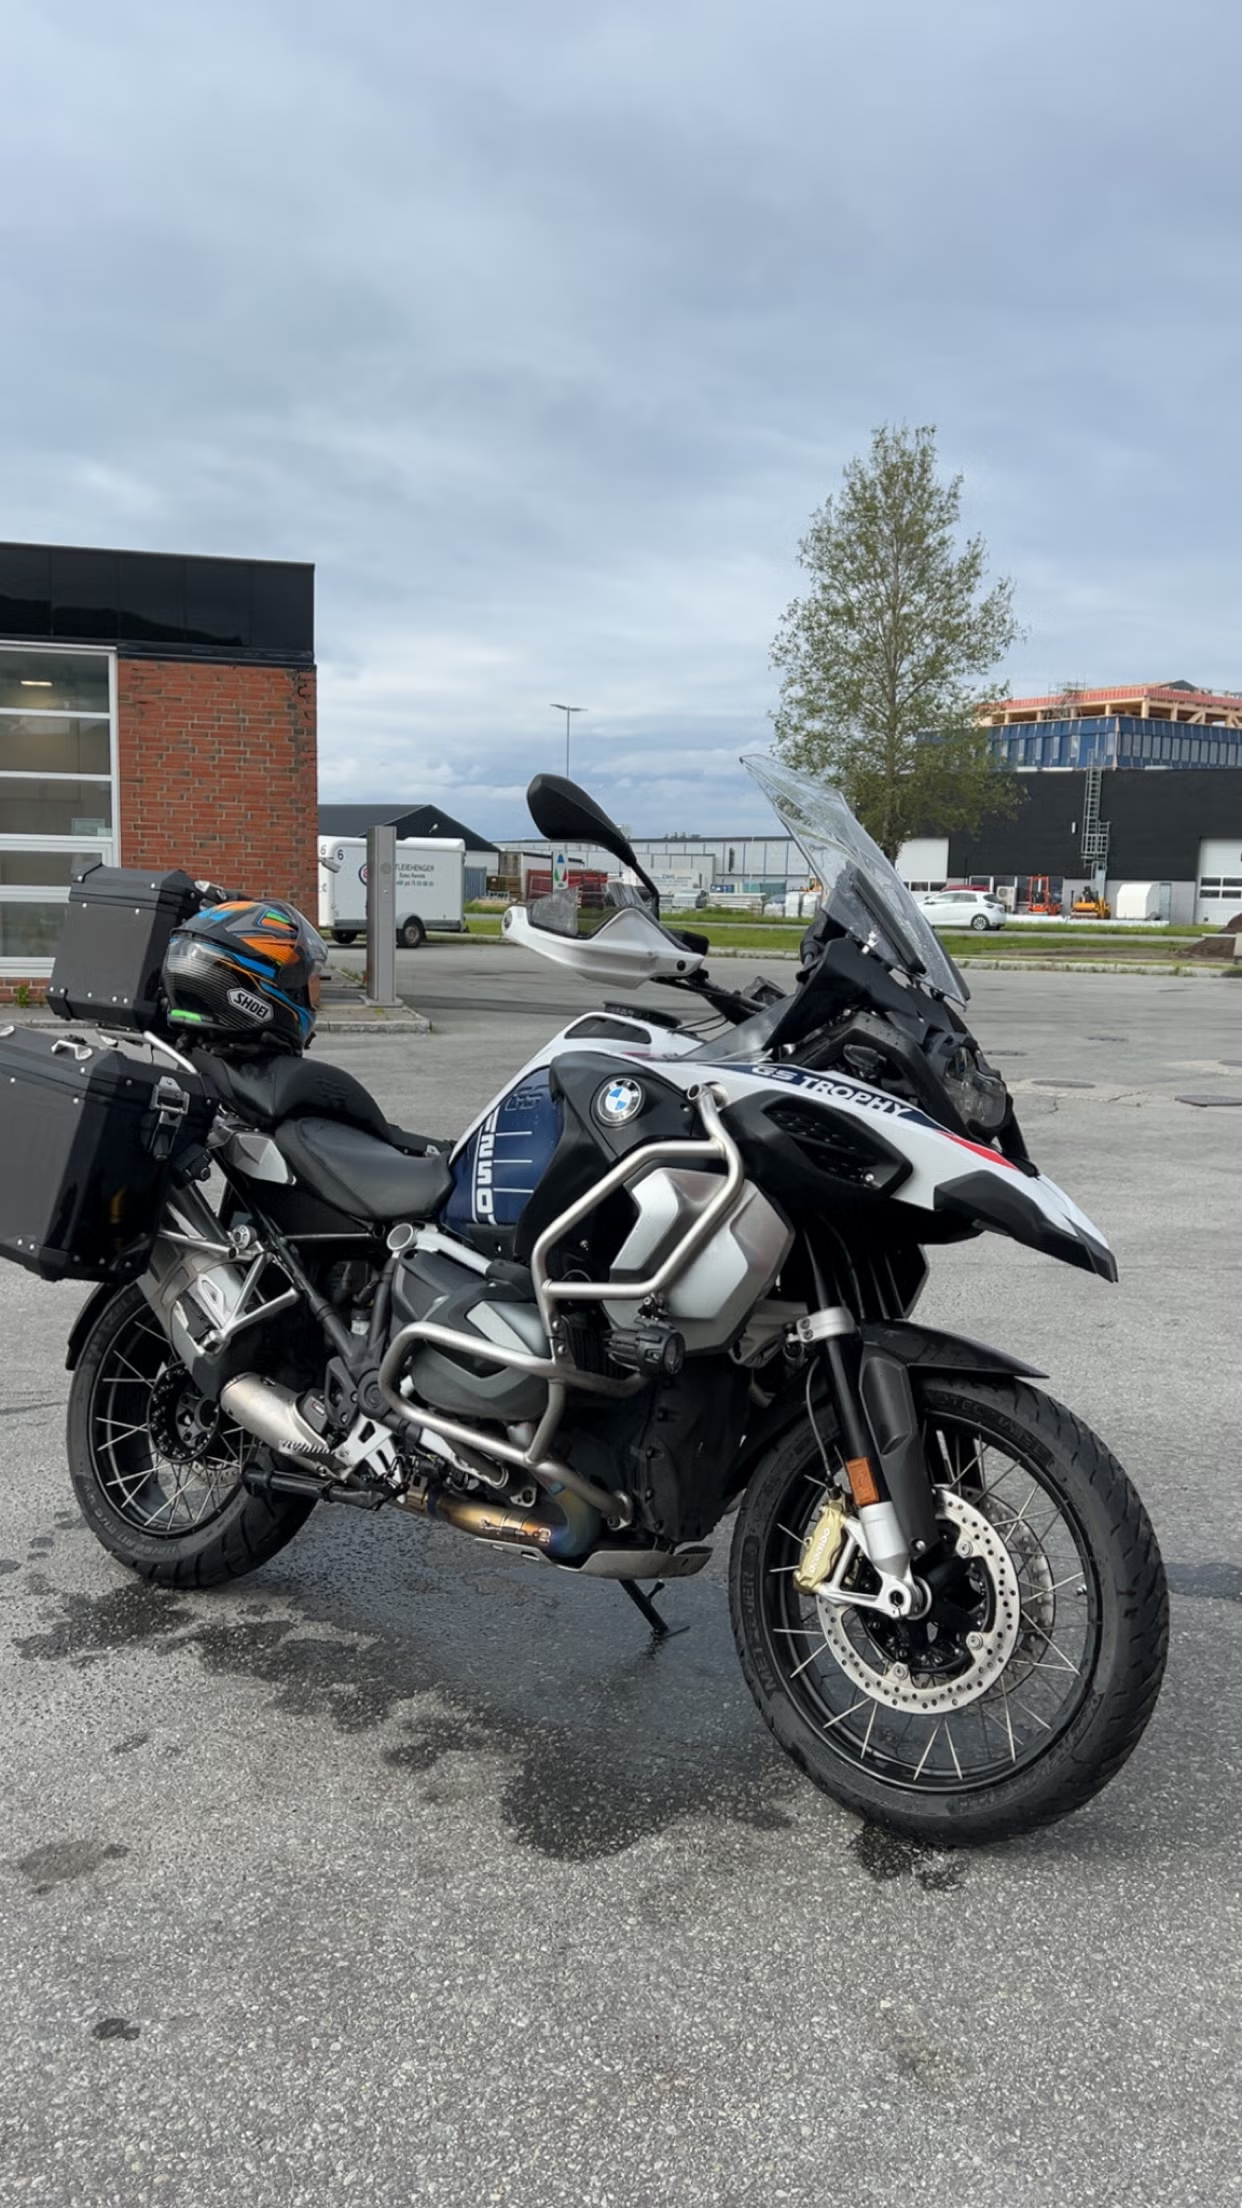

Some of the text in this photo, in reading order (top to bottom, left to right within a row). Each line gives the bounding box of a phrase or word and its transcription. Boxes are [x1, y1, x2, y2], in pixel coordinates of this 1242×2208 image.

[320, 844, 327, 855] 6
[337, 849, 344, 860] 6
[395, 863, 434, 872] TLEIEHENGER
[233, 992, 269, 1019] SHOEI
[752, 1065, 913, 1117] GS TROPHY
